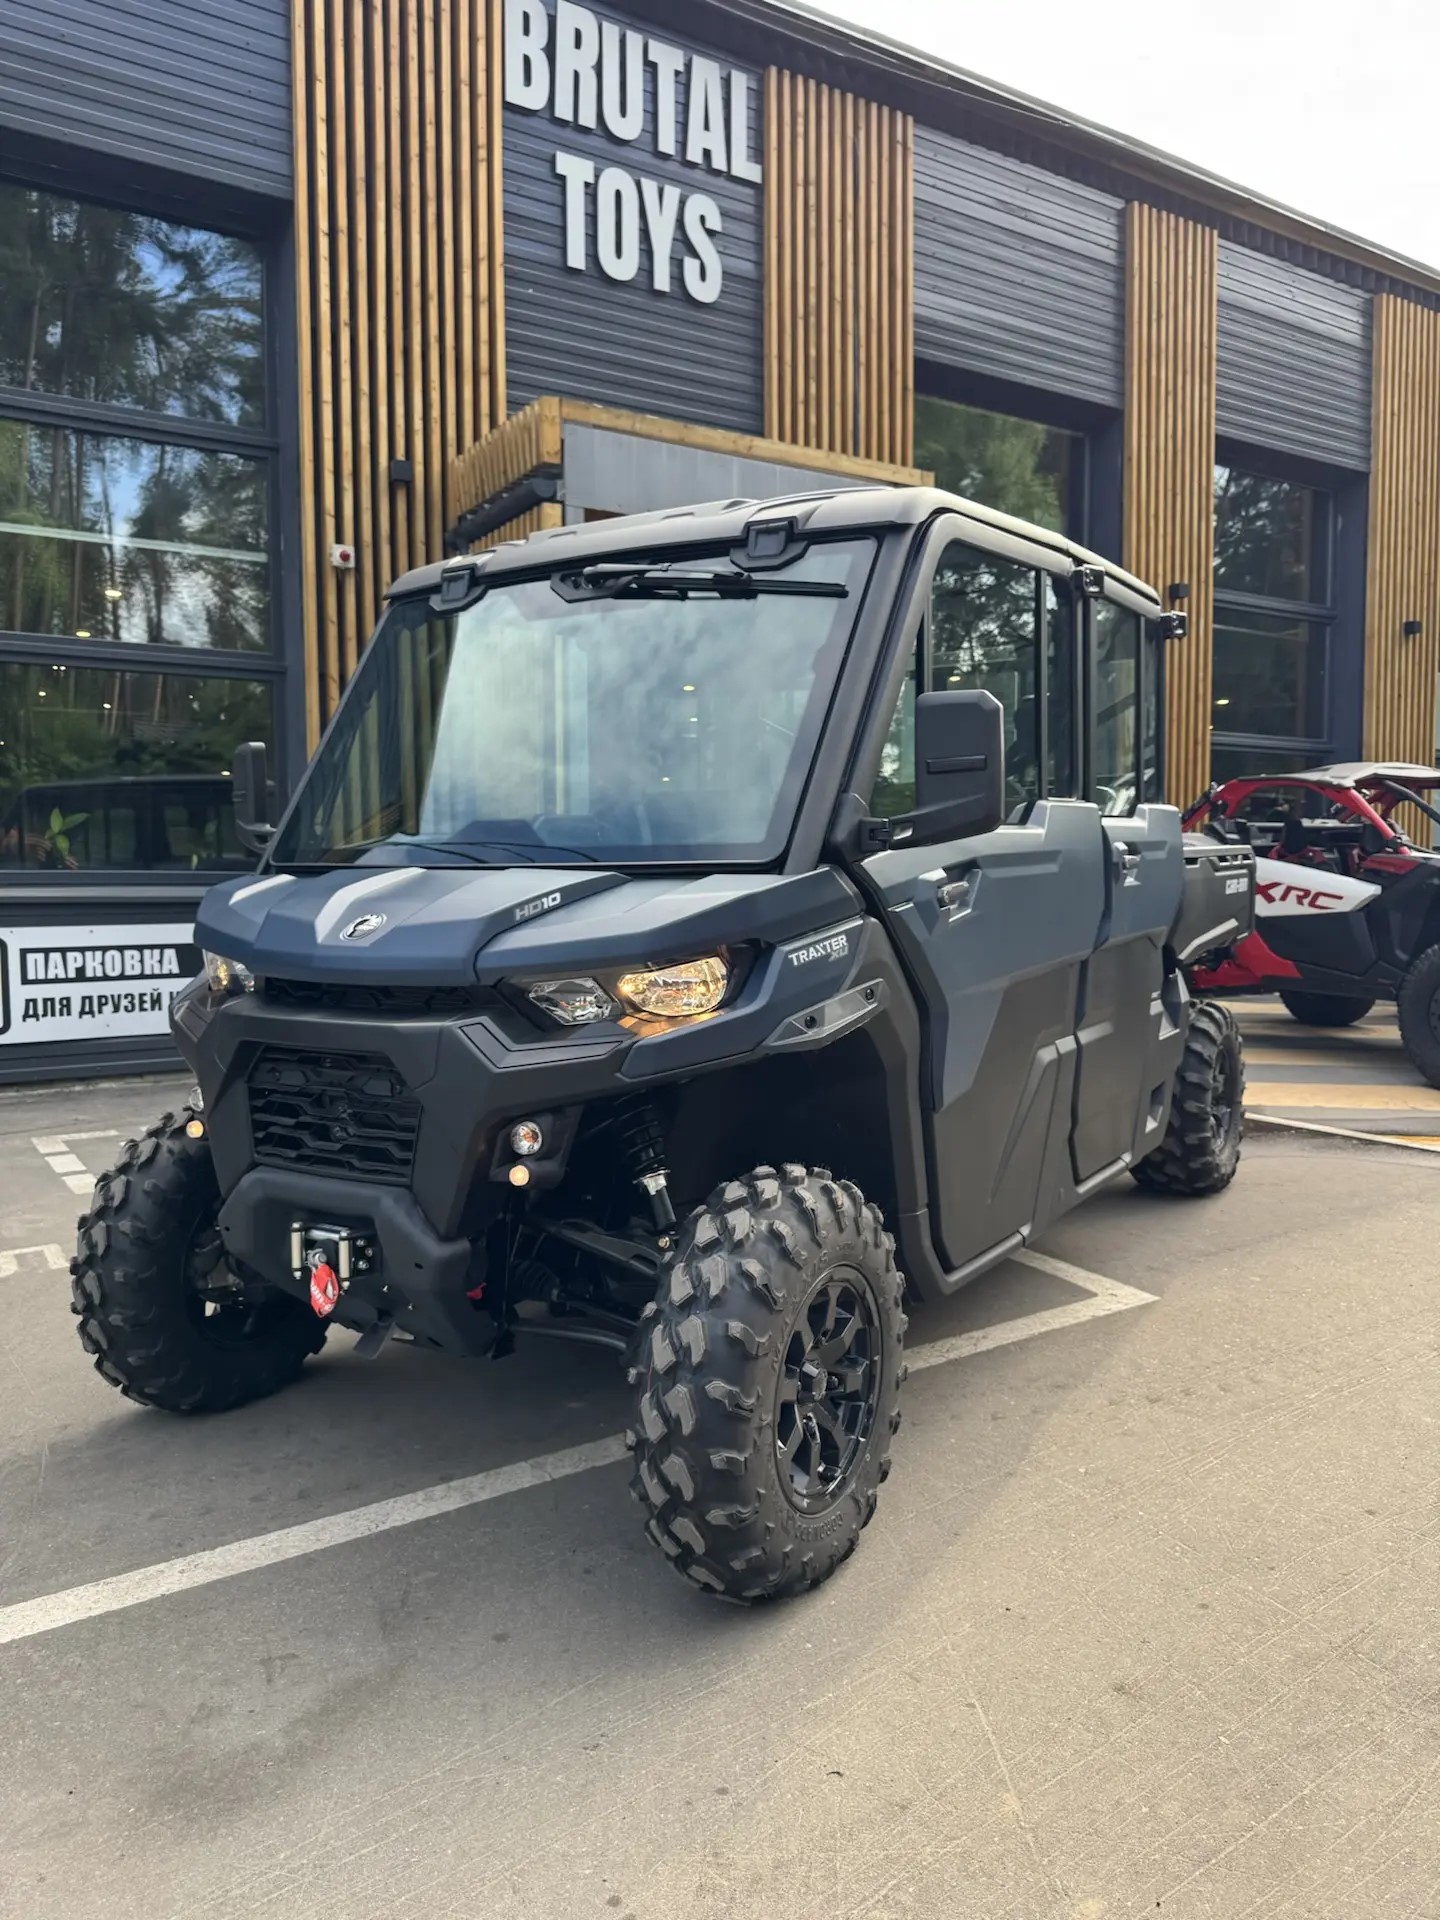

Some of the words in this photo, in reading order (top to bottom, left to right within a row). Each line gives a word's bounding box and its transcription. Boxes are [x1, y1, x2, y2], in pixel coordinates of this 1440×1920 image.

[504, 0, 762, 184] BRUTAL
[555, 150, 723, 304] TOYS
[515, 892, 561, 920] HD10
[26, 948, 180, 980] ПАРКОВКА
[788, 934, 848, 966] TRAXTER
[22, 997, 72, 1022] ДЛЯ
[78, 988, 163, 1019] ДРУЗЕЙ
